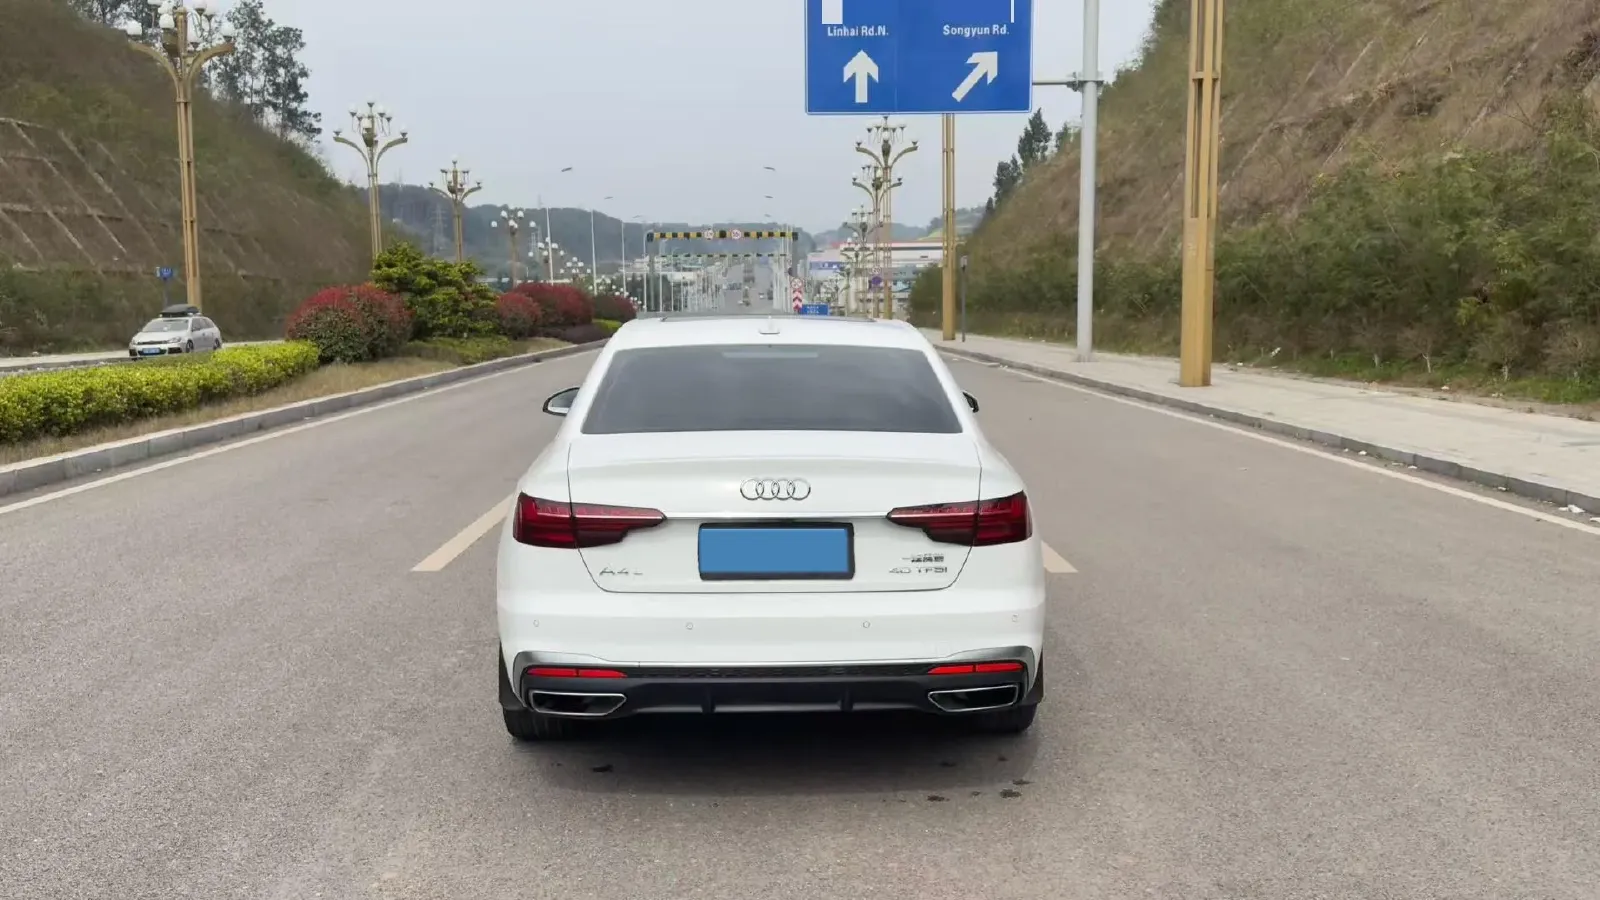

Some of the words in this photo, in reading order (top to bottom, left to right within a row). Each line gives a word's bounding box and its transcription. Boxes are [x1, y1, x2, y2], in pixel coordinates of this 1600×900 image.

[827, 25, 859, 36] Linhai
[861, 25, 889, 36] Rd.N.
[943, 24, 990, 37] Songyun
[992, 24, 1010, 35] Rd.
